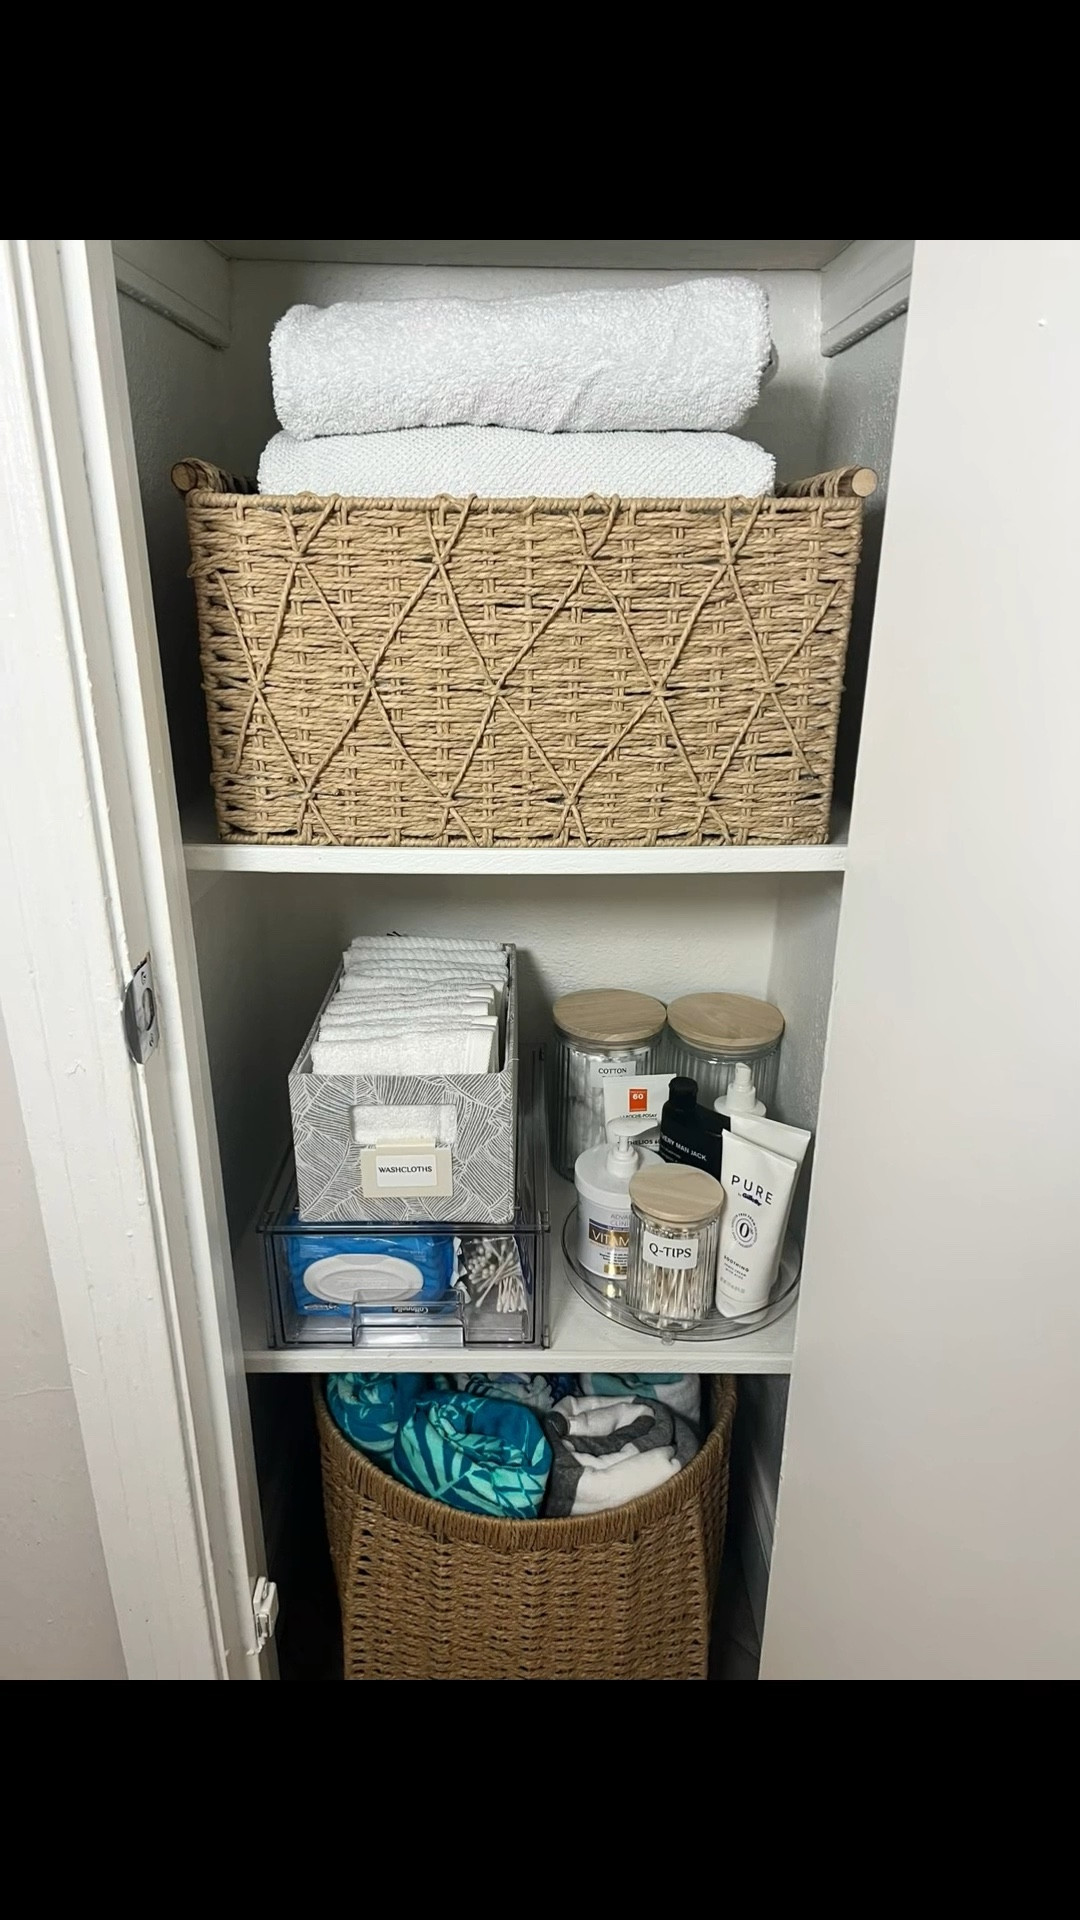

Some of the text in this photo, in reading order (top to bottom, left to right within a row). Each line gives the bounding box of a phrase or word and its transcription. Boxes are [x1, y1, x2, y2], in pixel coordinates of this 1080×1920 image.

[598, 1067, 628, 1075] COTTON
[675, 1142, 690, 1153] MAN
[378, 1165, 433, 1174] WASHCLOTHS
[731, 1174, 774, 1206] PURE
[591, 1228, 629, 1247] VITAM
[649, 1242, 692, 1259] Q-TIPS
